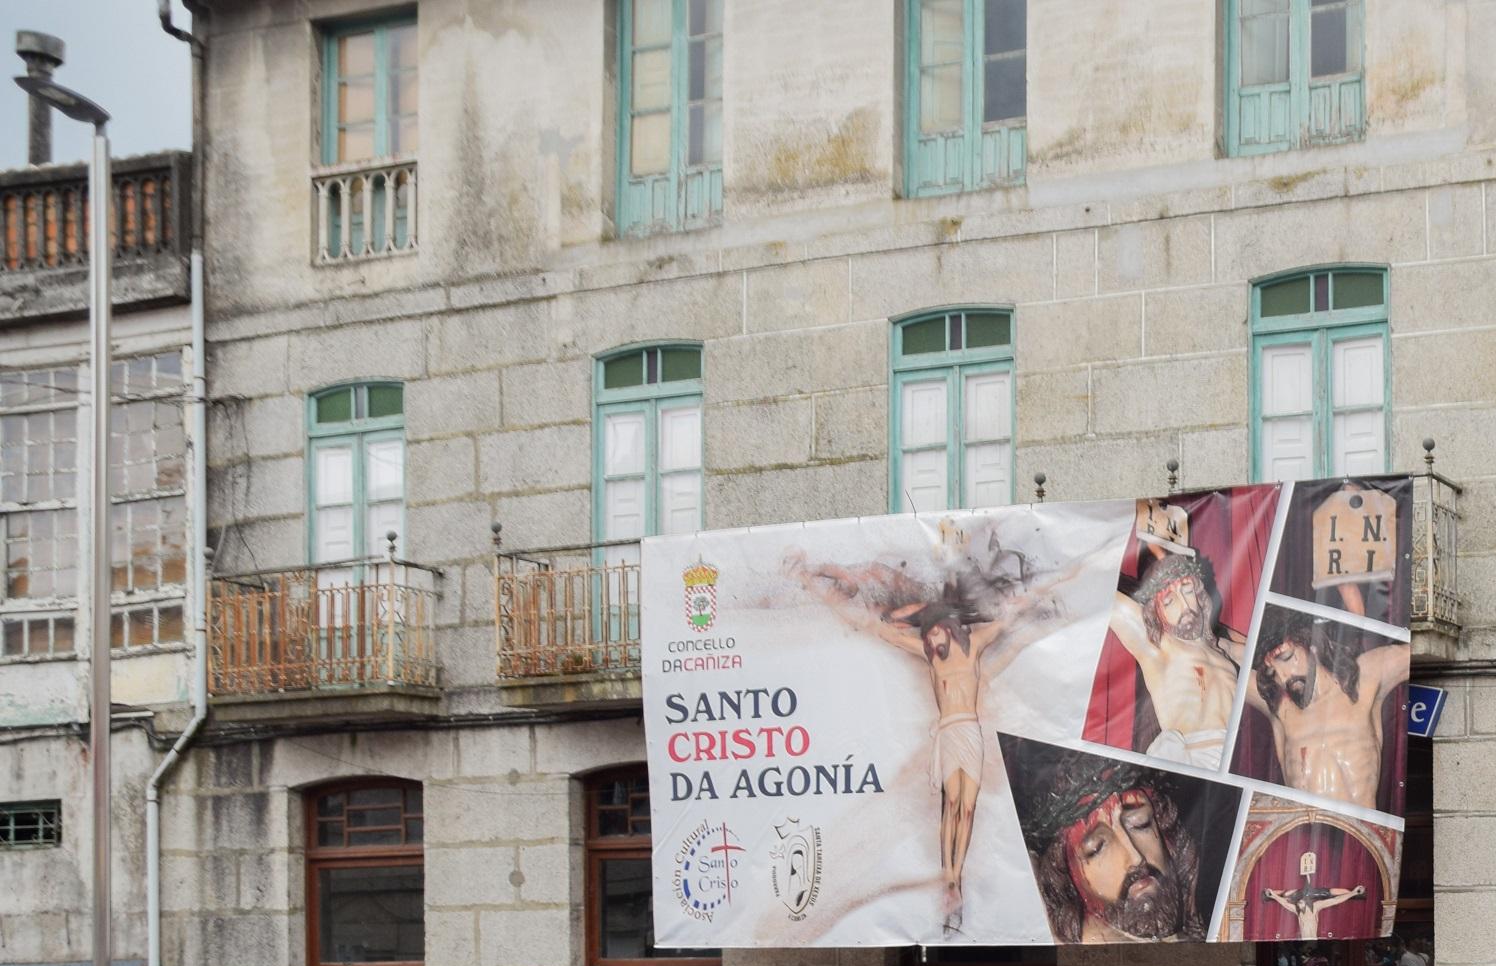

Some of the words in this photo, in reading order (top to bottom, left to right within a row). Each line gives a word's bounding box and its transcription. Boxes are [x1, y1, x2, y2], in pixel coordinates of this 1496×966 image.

[1361, 513, 1388, 542] N.
[667, 637, 736, 653] CONCELLO
[665, 687, 798, 725] SANTO
[667, 725, 810, 763] CRISTO
[669, 770, 719, 801] DA
[729, 754, 885, 799] AGONÍA
